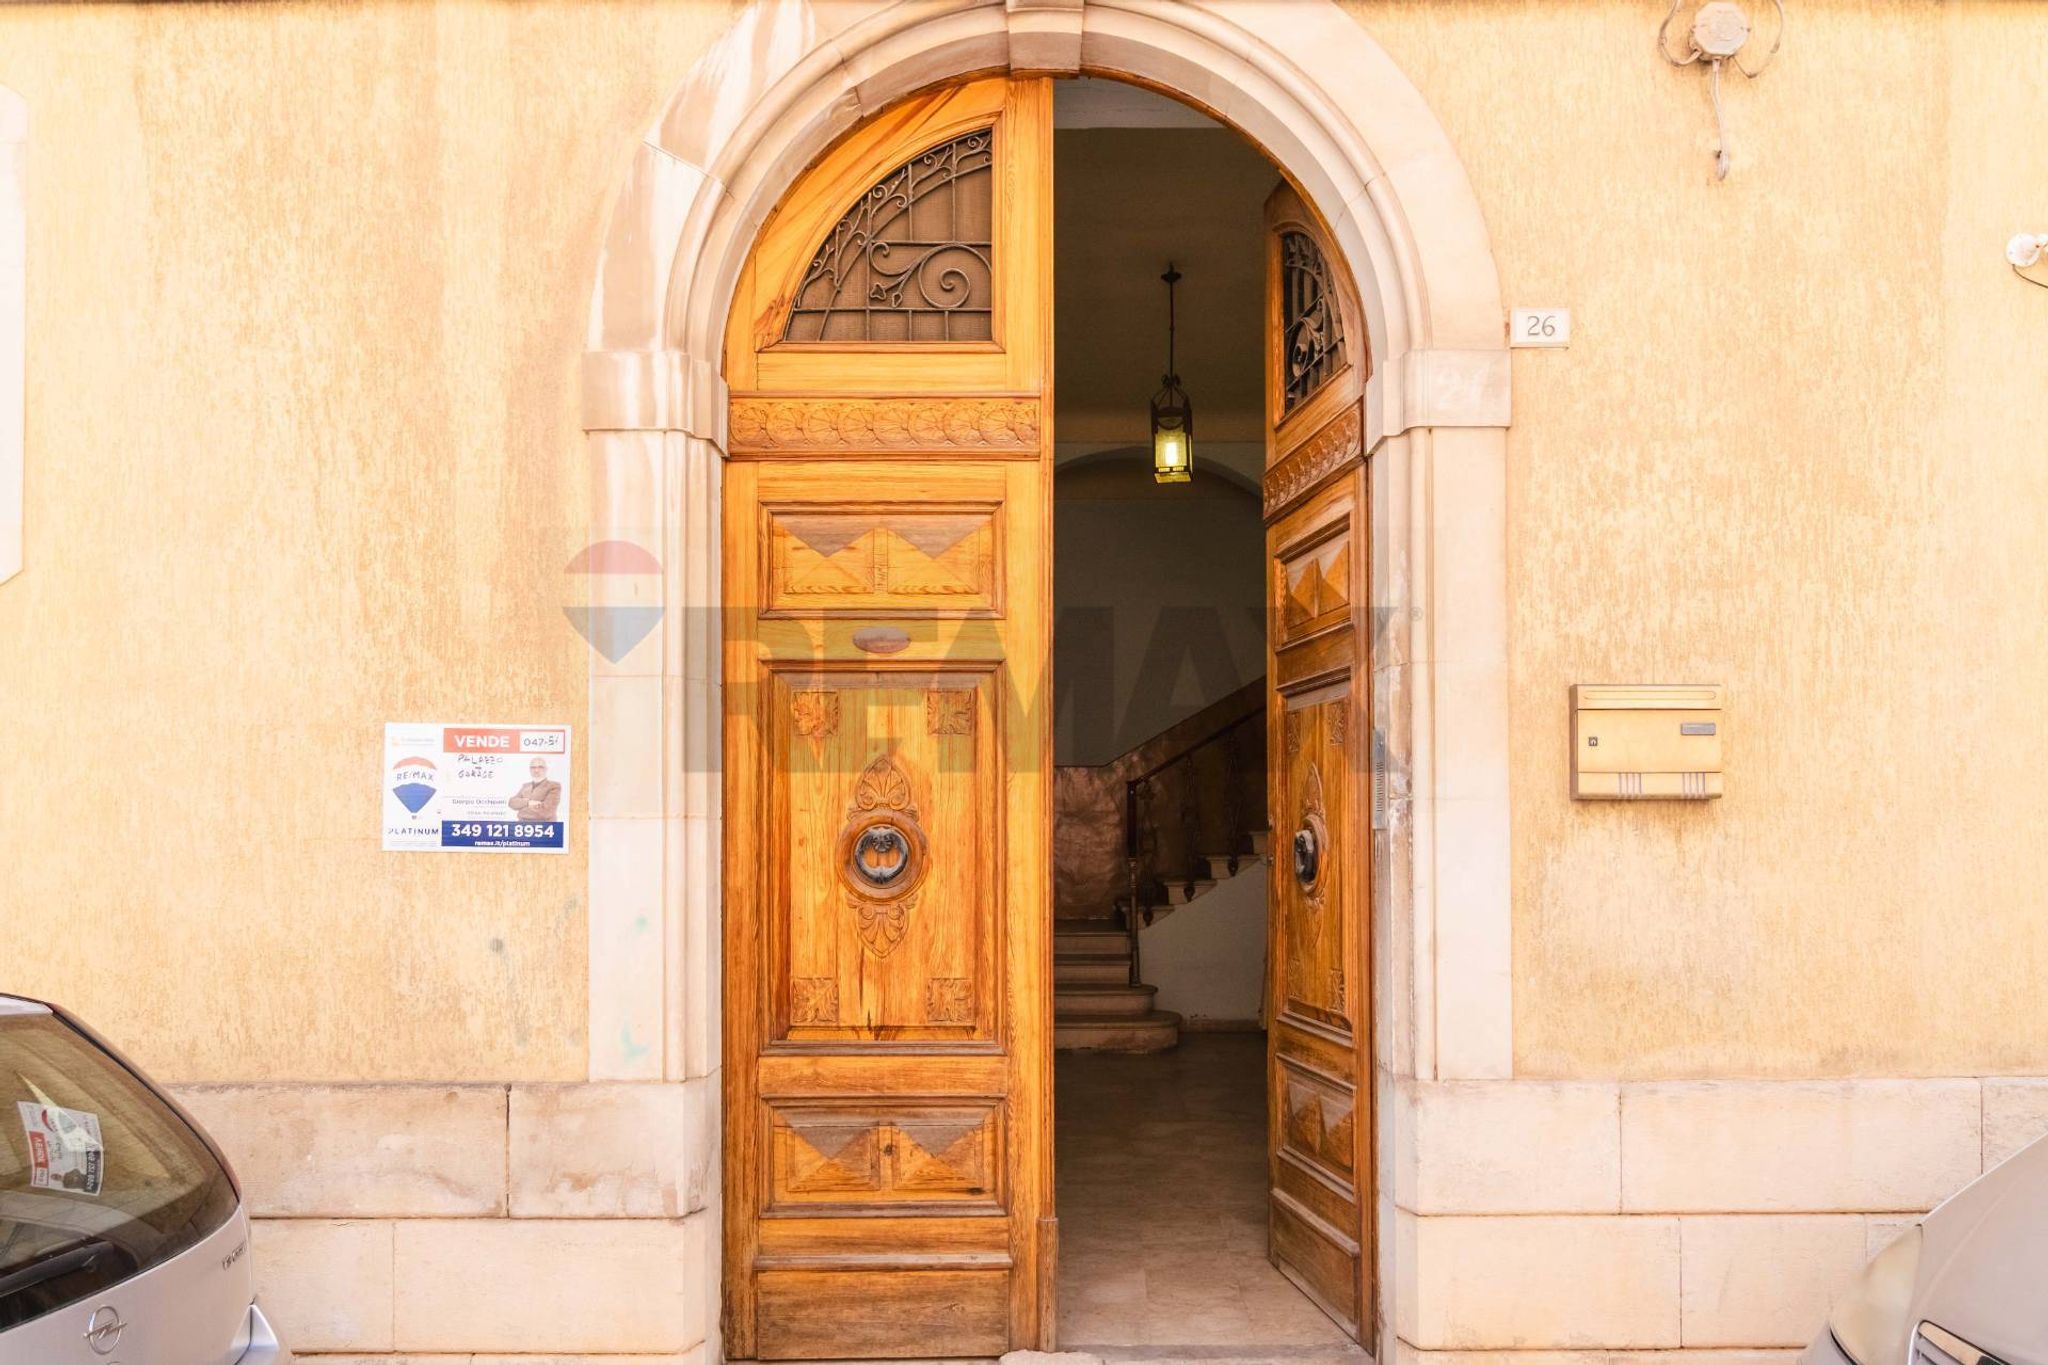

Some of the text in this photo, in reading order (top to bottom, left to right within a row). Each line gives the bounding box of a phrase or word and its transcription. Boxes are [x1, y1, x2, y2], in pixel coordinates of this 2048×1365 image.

[1527, 315, 1556, 337] 26
[454, 735, 510, 748] VENDE
[388, 827, 439, 835] PLATINUM
[451, 823, 555, 838] 349 121 8954
